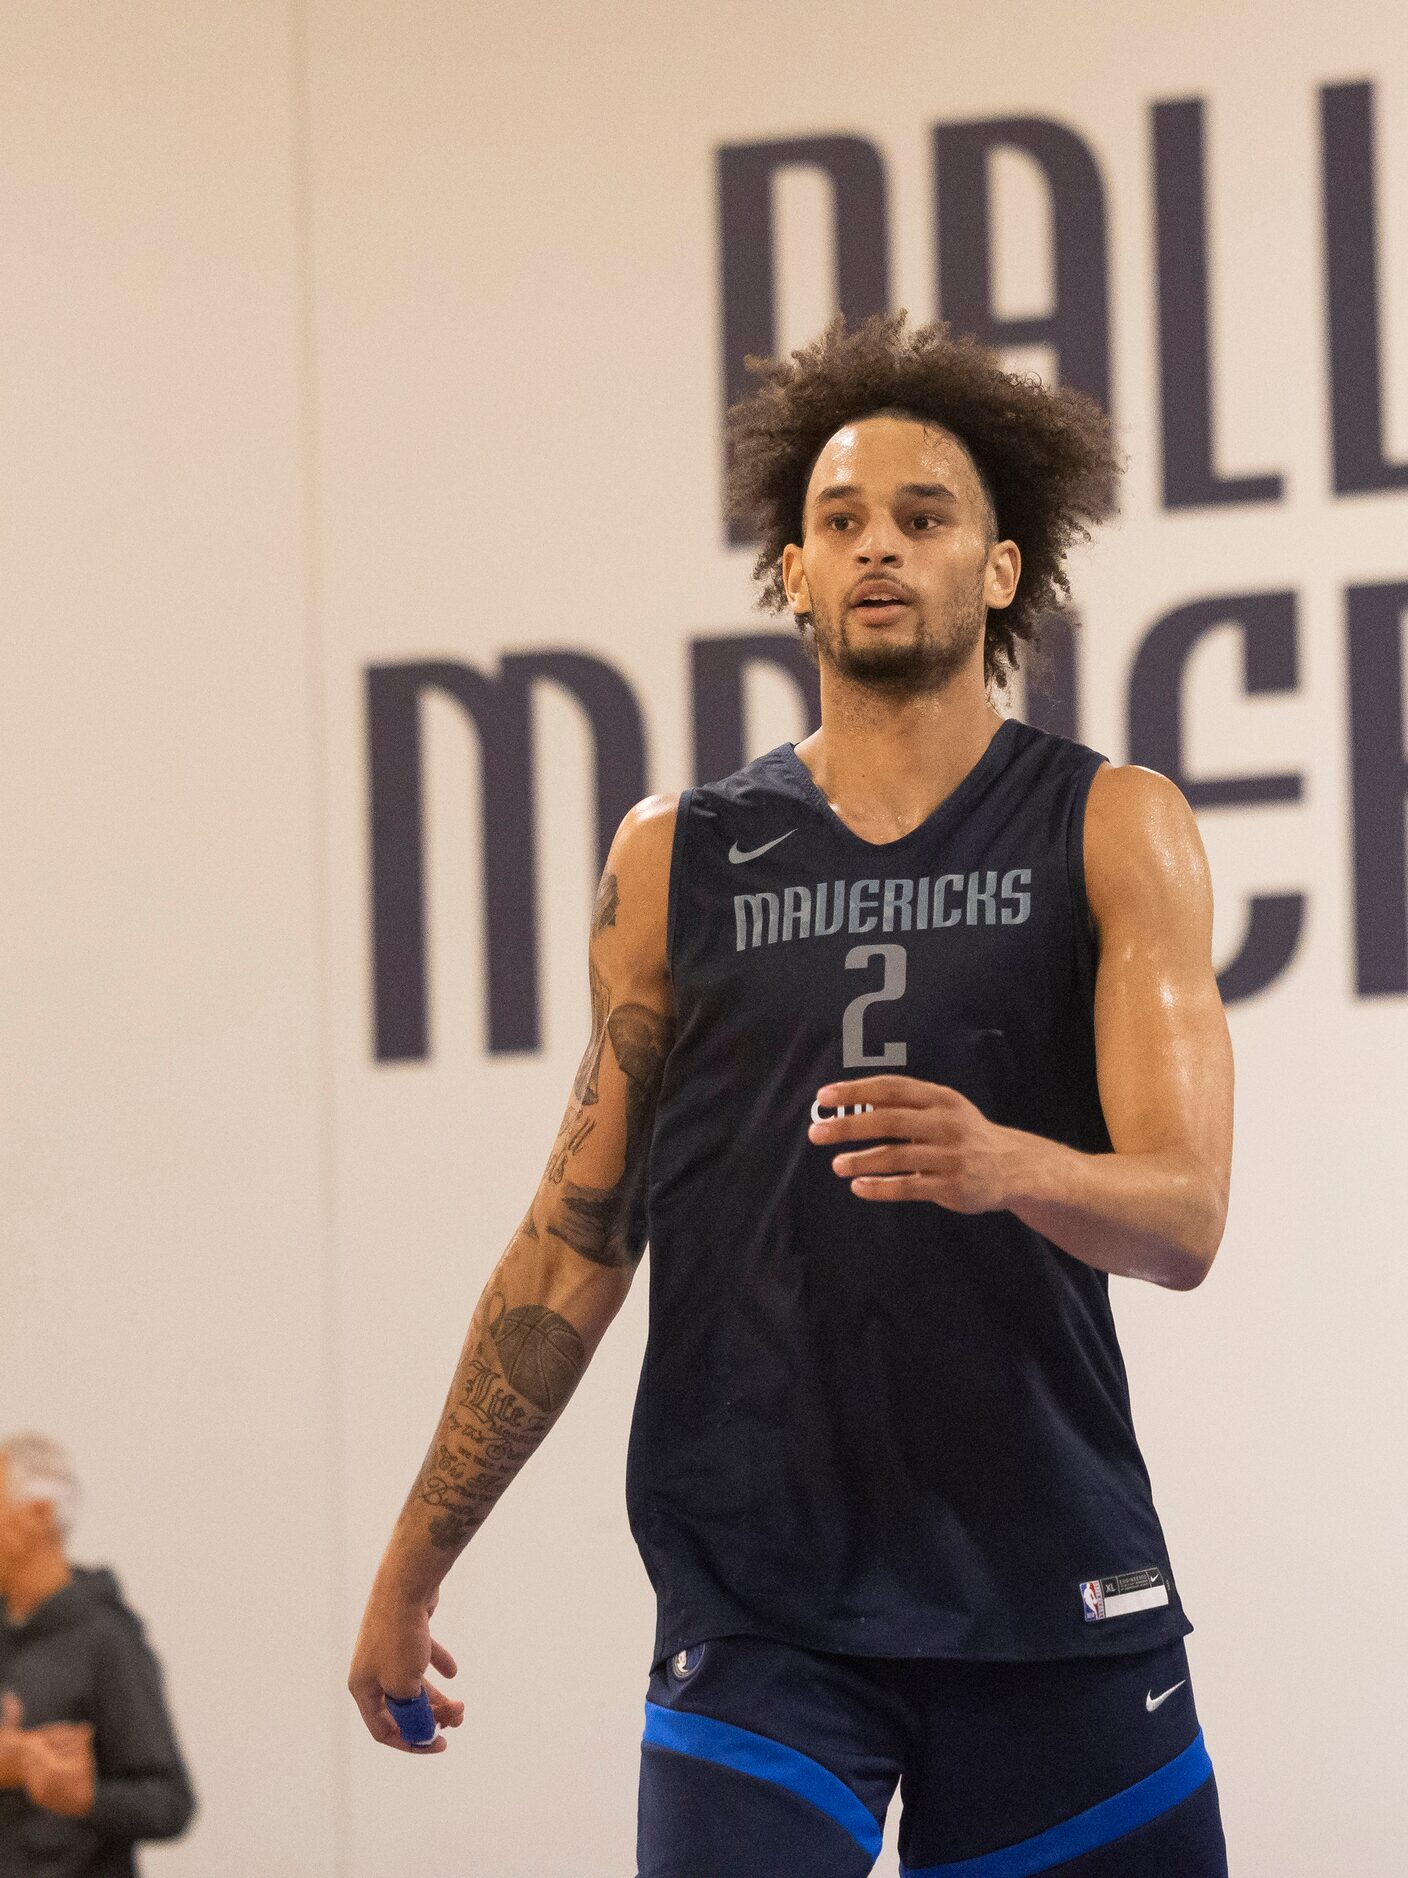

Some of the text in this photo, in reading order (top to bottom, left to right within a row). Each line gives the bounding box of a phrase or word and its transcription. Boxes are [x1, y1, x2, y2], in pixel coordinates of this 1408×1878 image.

[734, 868, 1032, 952] MAVERICKS
[842, 944, 907, 1068] 2
[1105, 1583, 1116, 1593] XL
